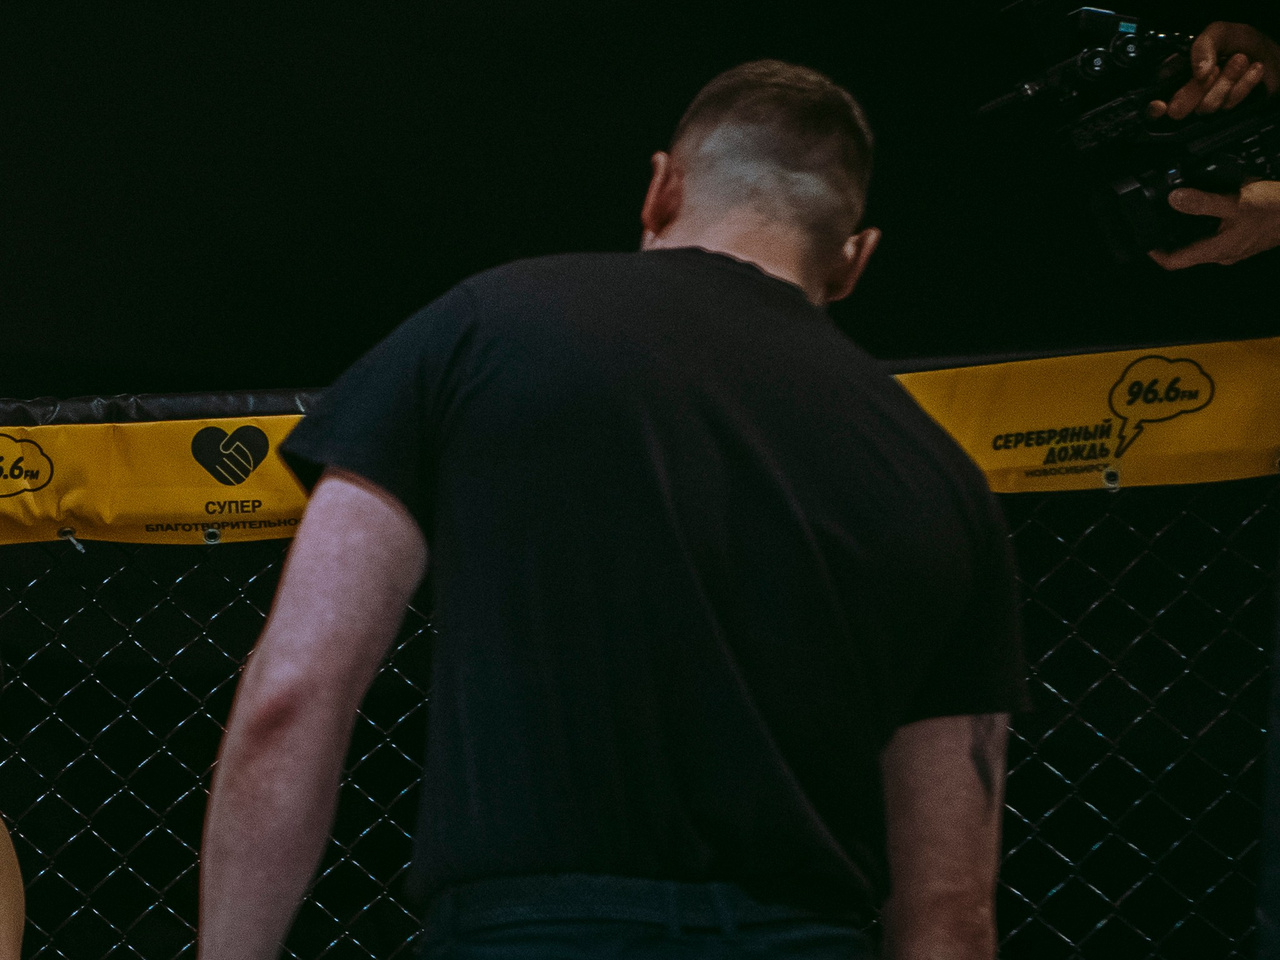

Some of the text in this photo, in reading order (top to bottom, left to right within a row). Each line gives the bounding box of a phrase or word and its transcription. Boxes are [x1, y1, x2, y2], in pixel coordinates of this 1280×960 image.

[992, 418, 1112, 451] СЕРЕБРЯНЫЙ
[1043, 443, 1111, 465] ДОЖДЬ
[205, 500, 262, 514] СУПЕР
[145, 518, 299, 532] БЛАГОТВОРИТЕЛЬНО
